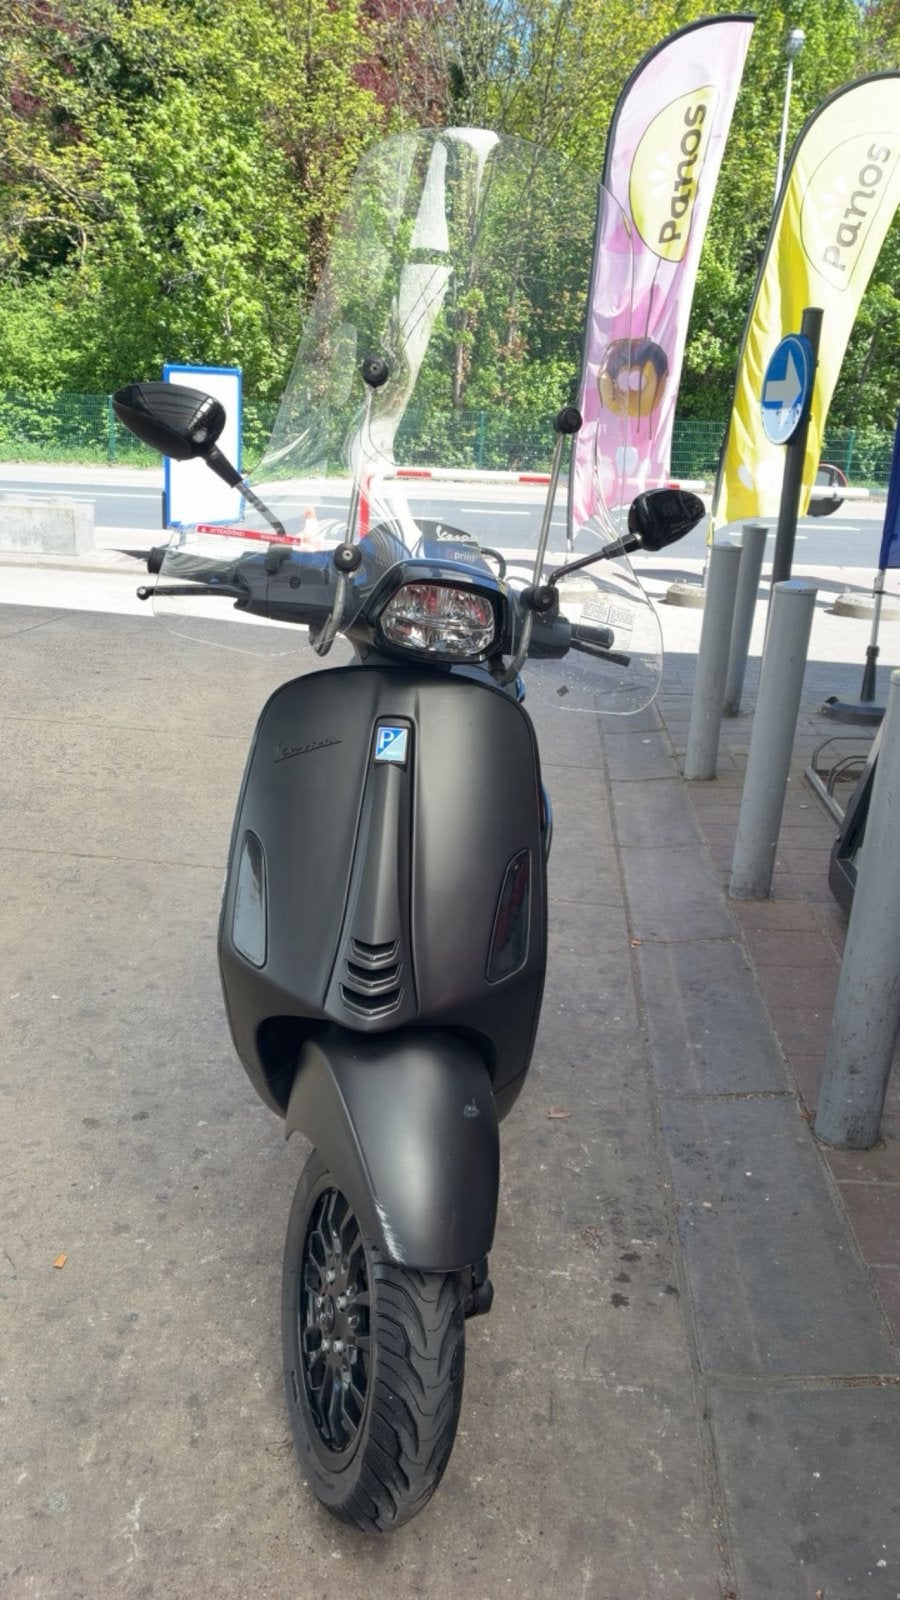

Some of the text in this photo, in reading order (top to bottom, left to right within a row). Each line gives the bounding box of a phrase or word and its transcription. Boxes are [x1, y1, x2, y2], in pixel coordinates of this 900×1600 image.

[658, 103, 707, 244] Panos
[822, 143, 891, 271] Panos
[436, 525, 480, 542] Vespa
